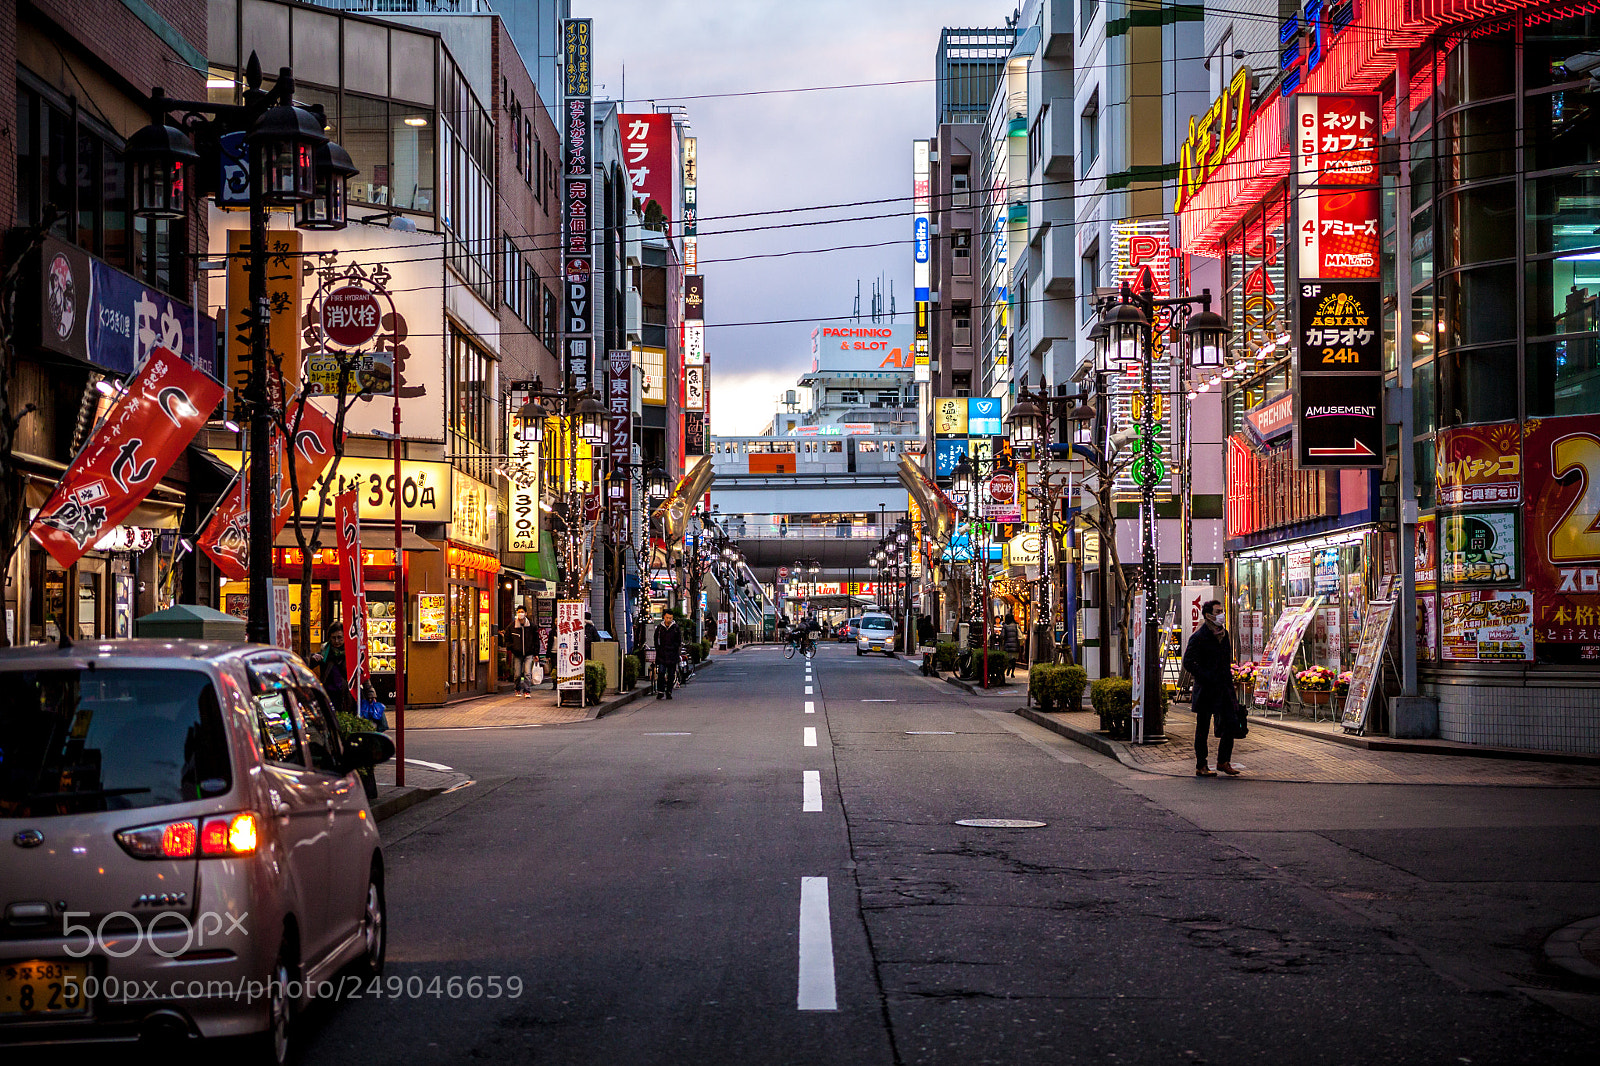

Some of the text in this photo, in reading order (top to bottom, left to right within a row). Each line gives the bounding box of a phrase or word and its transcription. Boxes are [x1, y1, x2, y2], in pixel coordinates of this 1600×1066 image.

[566, 23, 577, 94] インターネット
[1322, 111, 1374, 130] ネット
[569, 100, 586, 175] ホテルがライバル
[1174, 66, 1248, 216] パチンコ
[1321, 133, 1374, 153] カフェ
[626, 119, 650, 205] カラオケ
[569, 182, 587, 252] 完全個室
[1302, 219, 1316, 247] 4F
[1320, 218, 1378, 237] アミューズ
[916, 221, 927, 259] Berlitz
[1302, 285, 1322, 298] 3F
[326, 304, 377, 328] 消火栓
[571, 284, 586, 332] DVD
[99, 303, 131, 338] くつろぎの里
[1311, 316, 1370, 326] ASIAN
[823, 328, 892, 337] PACHINKO
[1305, 328, 1375, 347] カラオケ
[840, 342, 888, 350] & SLOT
[1129, 236, 1166, 487] PANKO
[1322, 348, 1359, 364] 24h
[1305, 405, 1376, 417] AMUSEMENT
[991, 483, 1014, 493] 消火栓
[1444, 549, 1505, 564] スロット
[343, 506, 365, 690] らーめん
[559, 619, 583, 635] 禁止
[37, 964, 63, 980] 583
